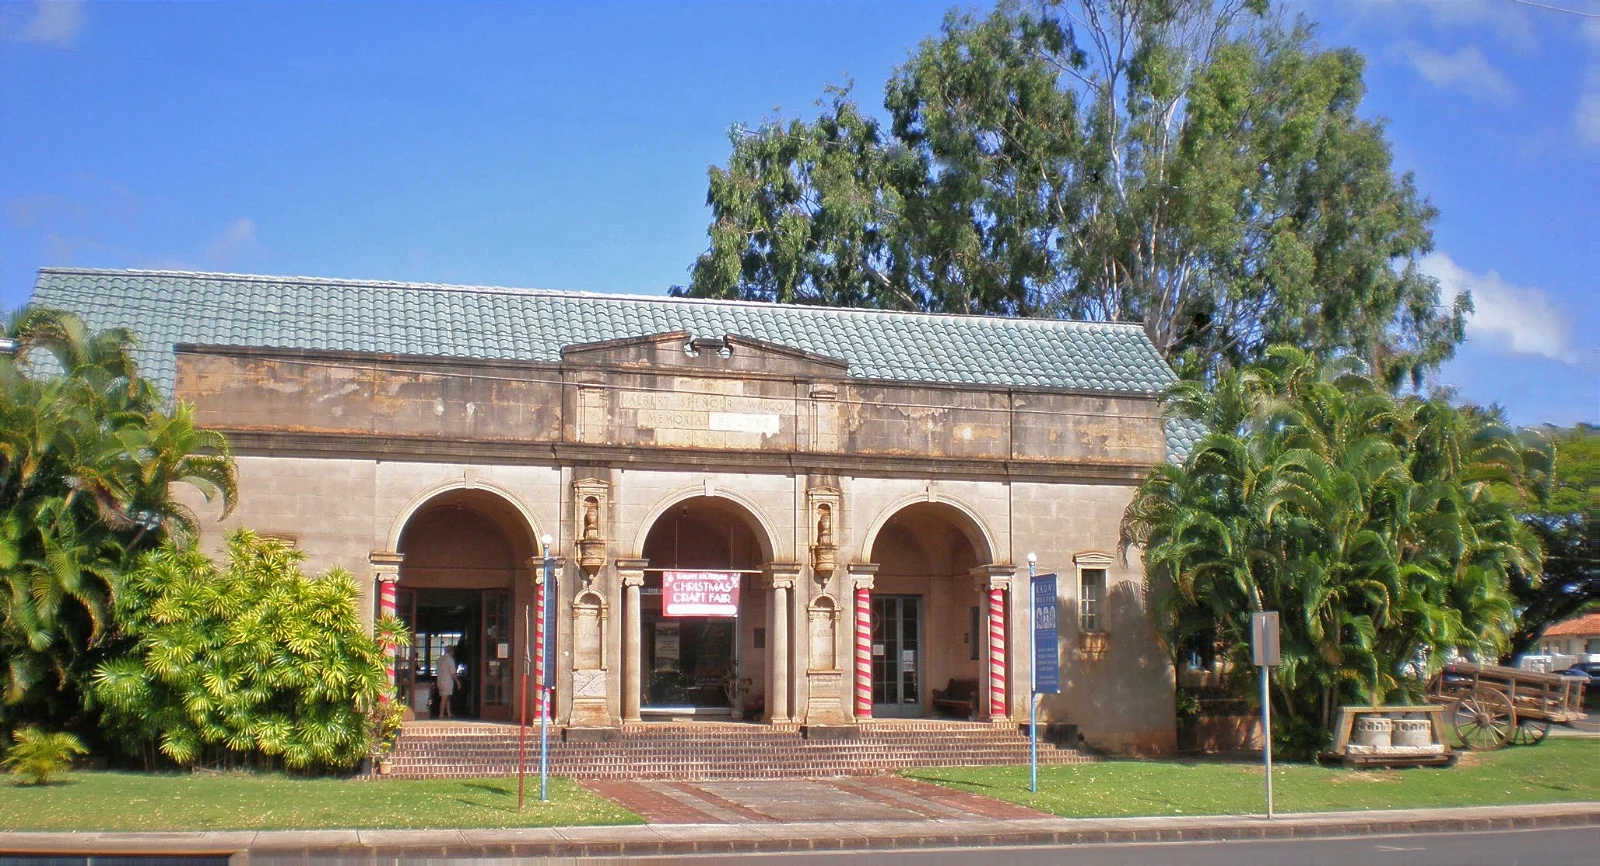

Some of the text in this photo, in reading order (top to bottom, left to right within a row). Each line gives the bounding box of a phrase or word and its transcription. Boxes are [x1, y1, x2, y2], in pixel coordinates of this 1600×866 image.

[629, 396, 791, 411] ALBERT SPENCER WILCOX
[648, 414, 709, 426] MEMORIAL
[672, 582, 732, 592] CHRISTMAS
[672, 592, 731, 603] CRAFT FAIR
